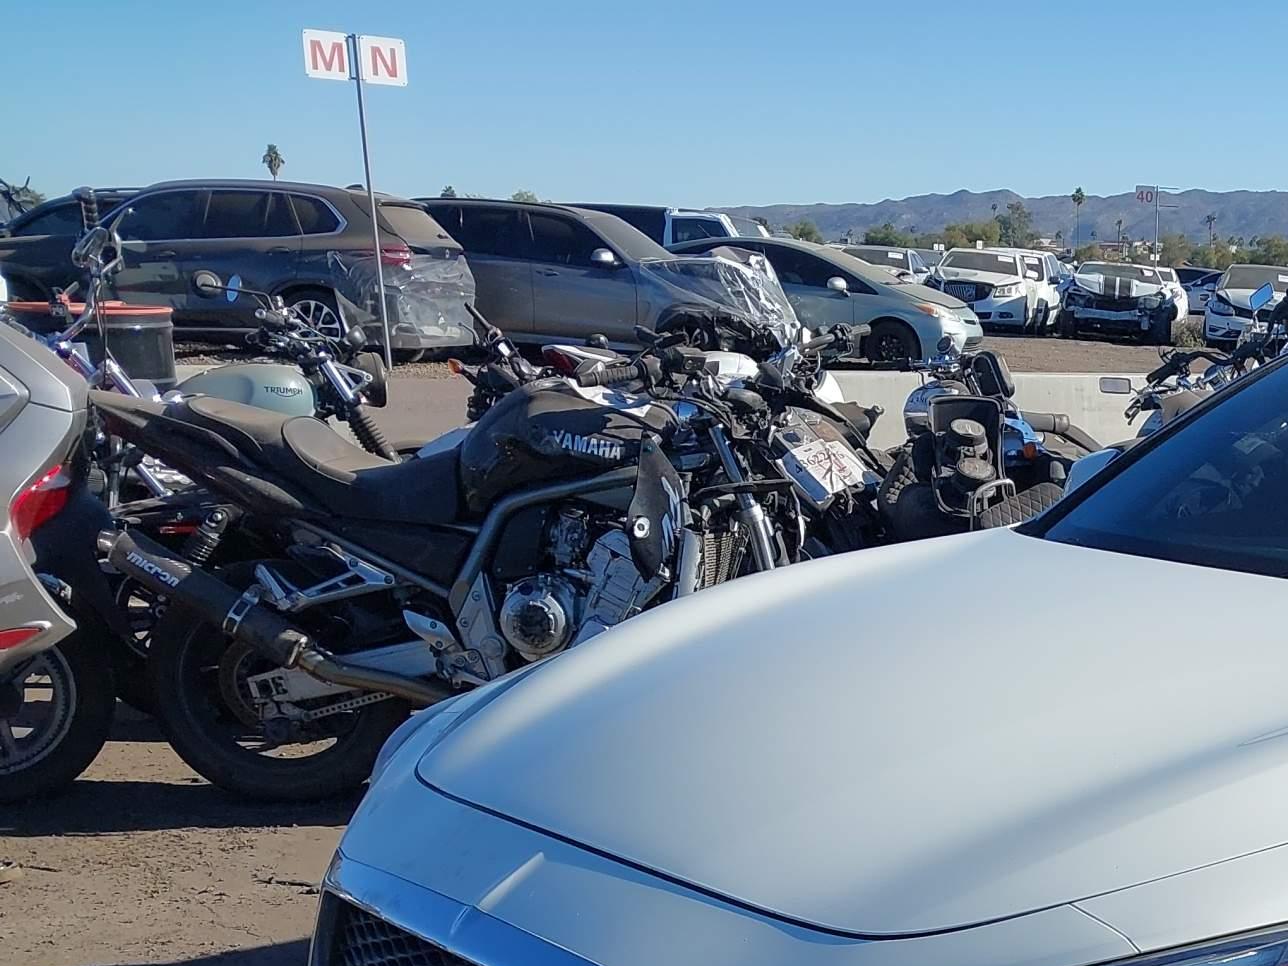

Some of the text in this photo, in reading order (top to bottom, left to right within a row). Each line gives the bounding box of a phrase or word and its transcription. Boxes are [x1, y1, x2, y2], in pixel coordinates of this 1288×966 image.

[309, 39, 398, 78] M N
[1136, 190, 1154, 203] 40
[263, 385, 303, 395] TRIUMPH
[552, 429, 621, 460] YAMAHA
[126, 551, 181, 588] micron
